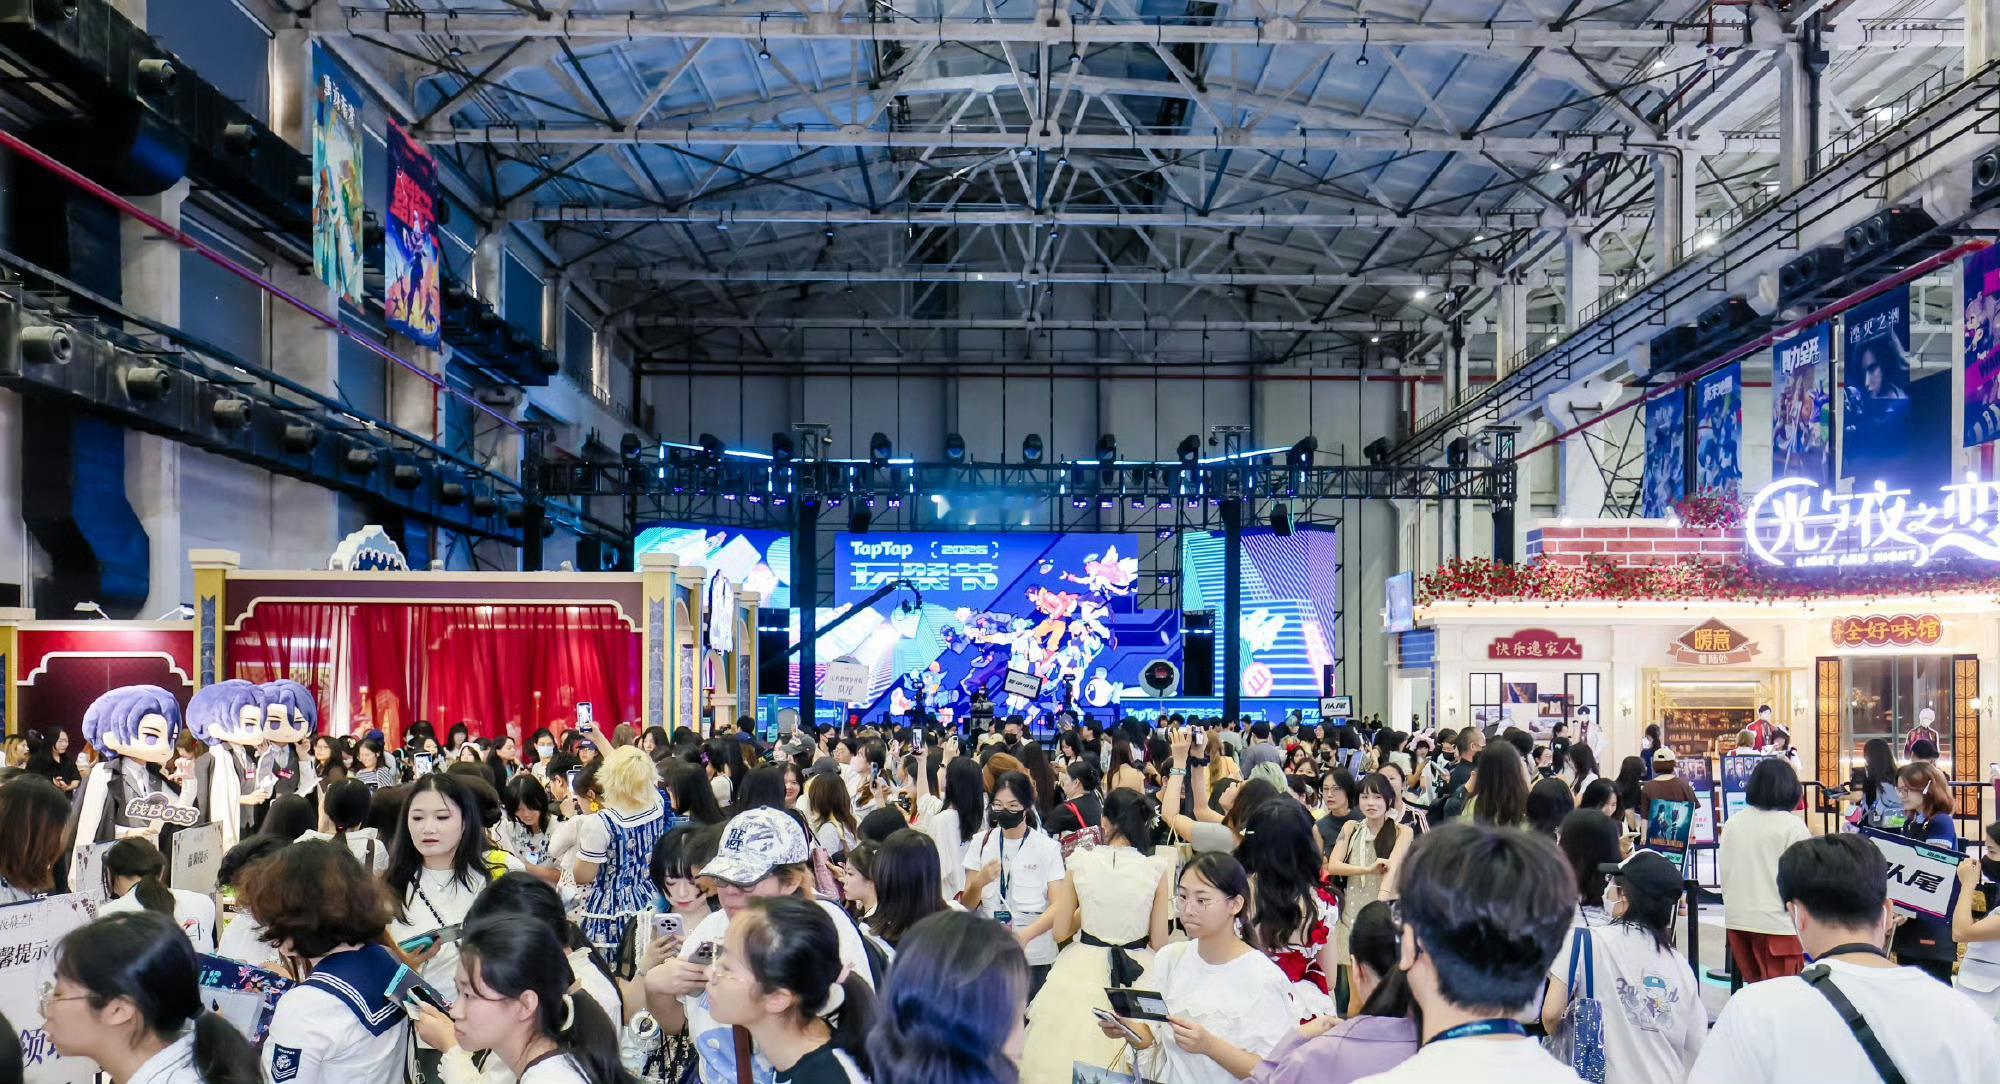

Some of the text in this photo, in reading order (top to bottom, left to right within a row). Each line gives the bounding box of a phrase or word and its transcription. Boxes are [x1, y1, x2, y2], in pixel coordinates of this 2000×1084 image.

[850, 541, 912, 559] TapTap
[1839, 553, 1869, 566] AND
[1495, 641, 1578, 657] 快乐逸家人
[1694, 629, 1730, 651] 暖意
[0, 940, 49, 969] 馨提示
